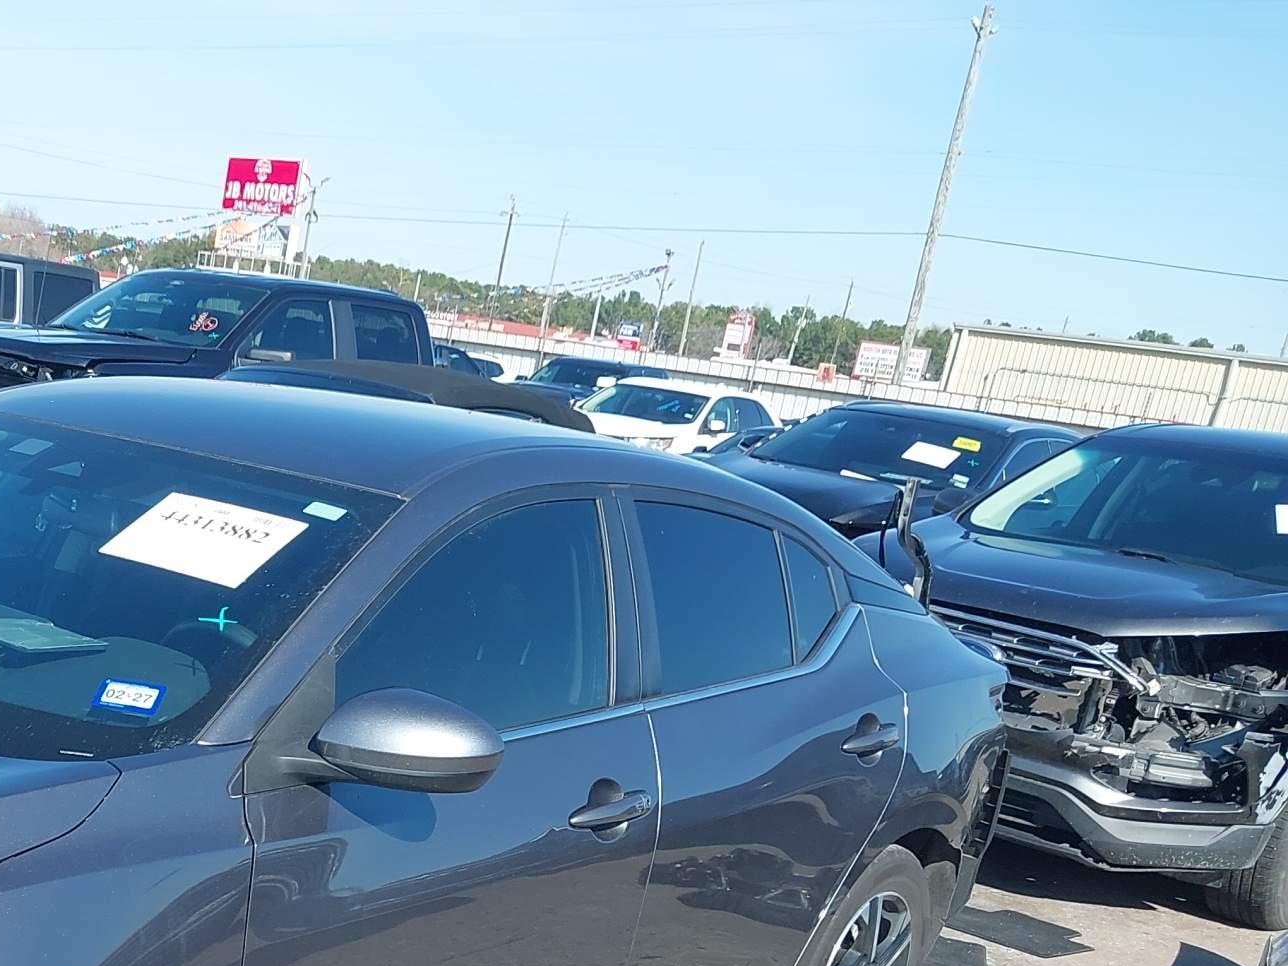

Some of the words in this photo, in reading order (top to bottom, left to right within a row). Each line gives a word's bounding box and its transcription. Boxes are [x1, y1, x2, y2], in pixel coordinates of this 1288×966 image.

[225, 180, 241, 200] JB
[242, 181, 295, 206] MOTORS
[161, 511, 270, 543] 44313882
